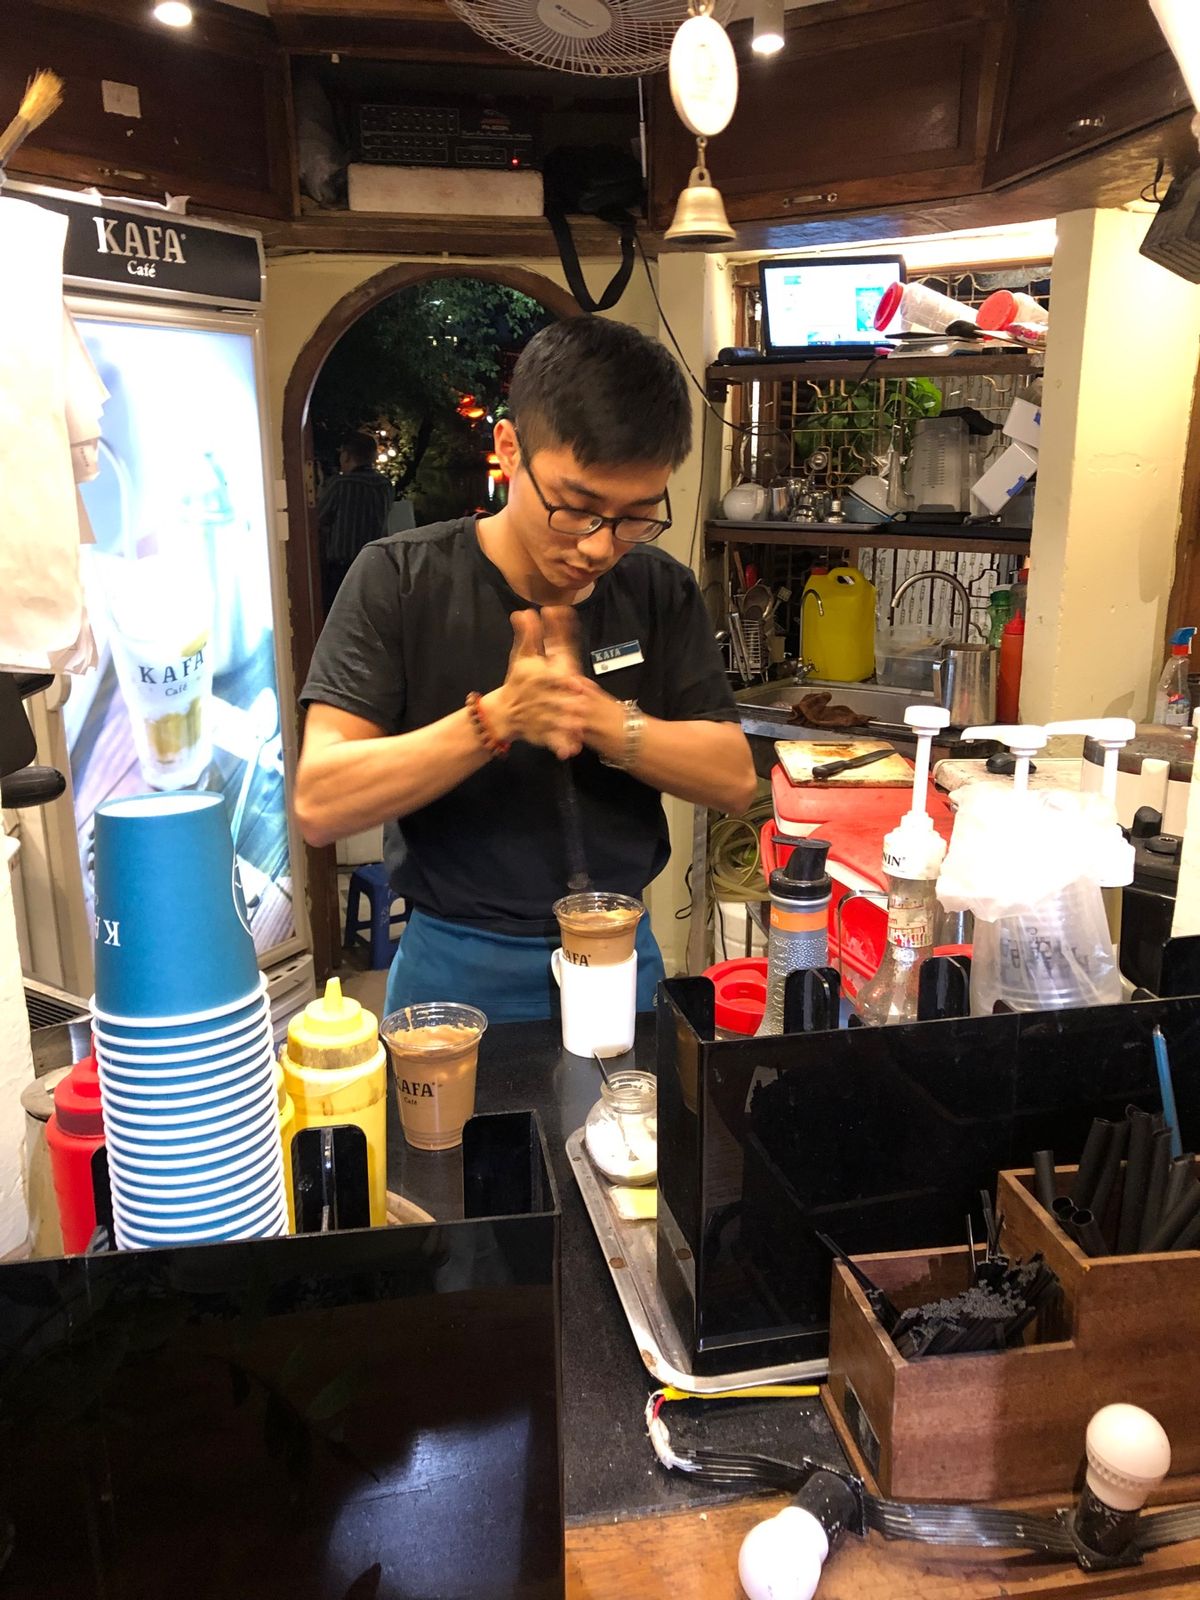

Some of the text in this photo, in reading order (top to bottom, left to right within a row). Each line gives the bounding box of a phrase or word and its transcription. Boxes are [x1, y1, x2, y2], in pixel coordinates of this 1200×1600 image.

[92, 216, 187, 264] KAFA
[127, 260, 156, 278] Café
[138, 649, 204, 685] KAFA
